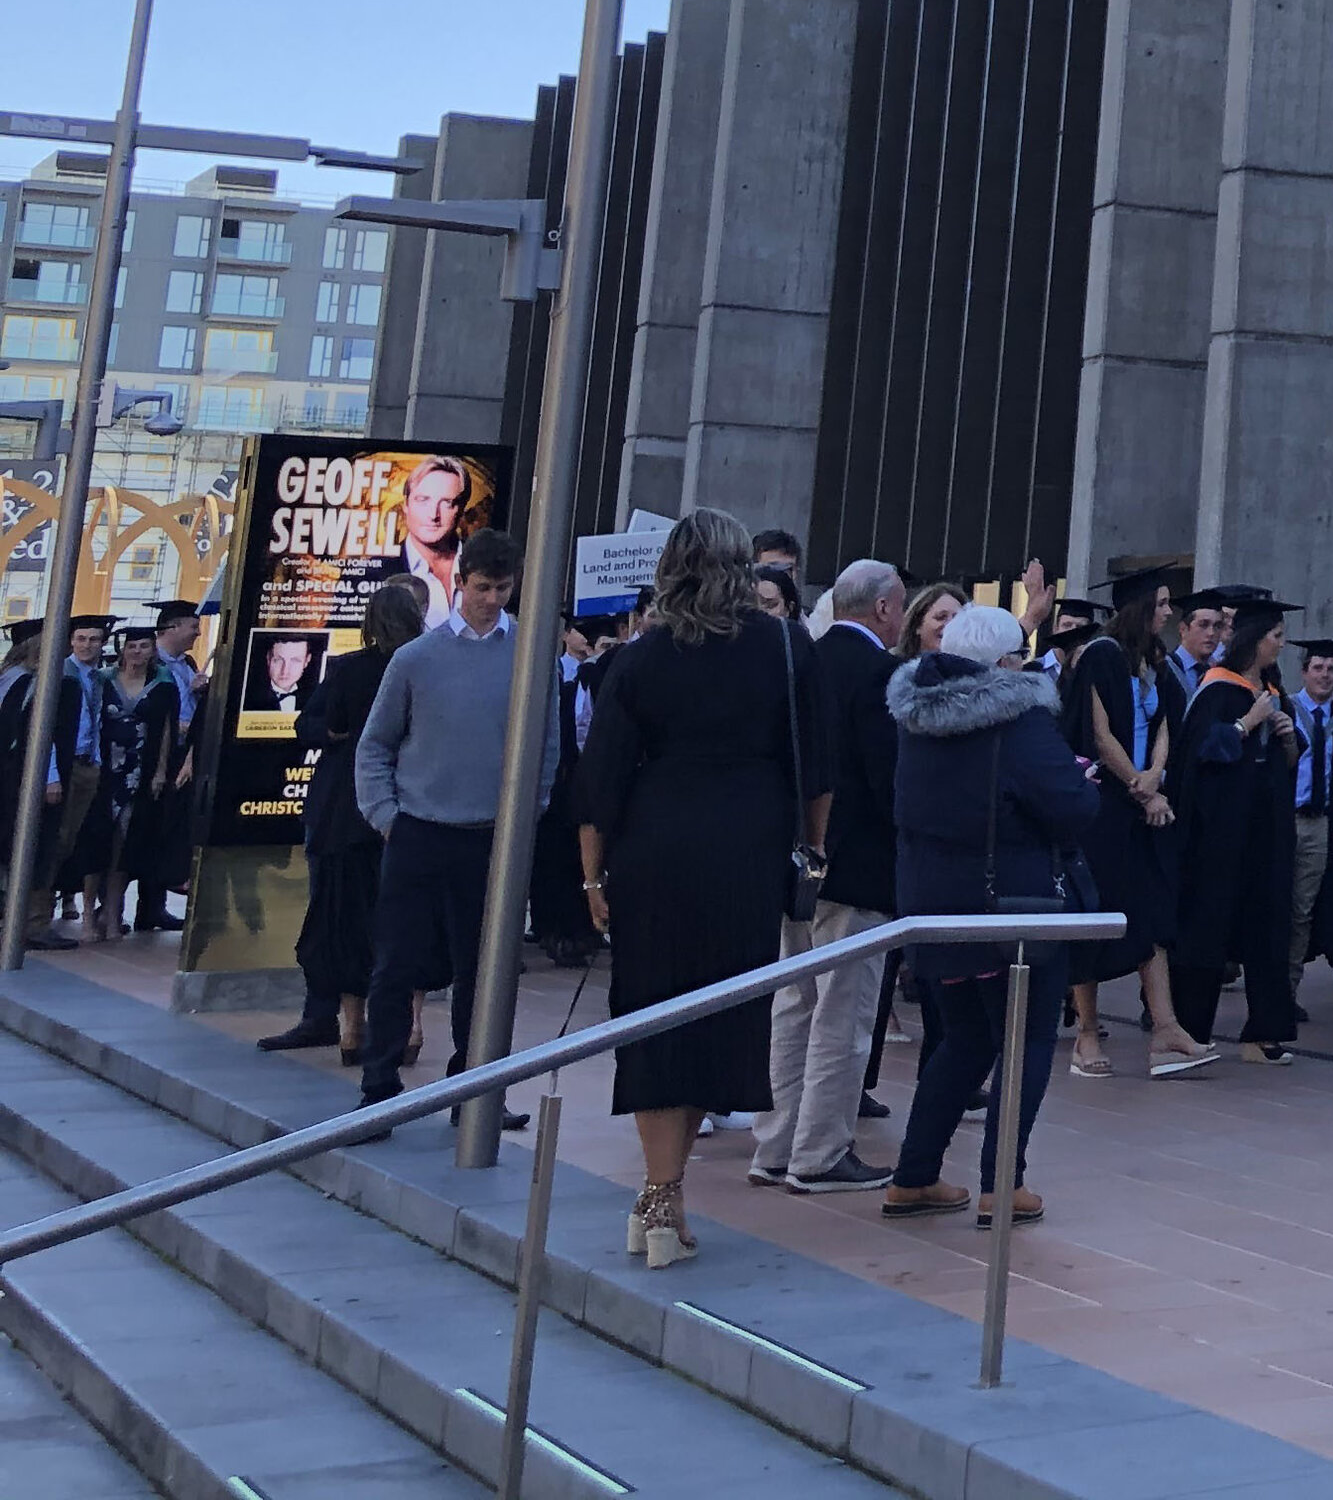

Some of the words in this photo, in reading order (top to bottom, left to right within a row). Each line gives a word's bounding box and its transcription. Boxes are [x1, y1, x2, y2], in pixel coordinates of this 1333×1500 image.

[278, 456, 392, 506] GEOFF
[269, 507, 401, 557] SEWELL
[603, 546, 653, 558] Bachelor
[656, 546, 665, 555] o
[583, 562, 612, 574] Land
[614, 559, 636, 571] and
[638, 559, 658, 569] Pro
[262, 579, 292, 592] and
[295, 580, 355, 593] SPECIAL
[597, 573, 654, 585] Managem
[285, 767, 316, 781] WE
[240, 800, 304, 815] CHRISTC
